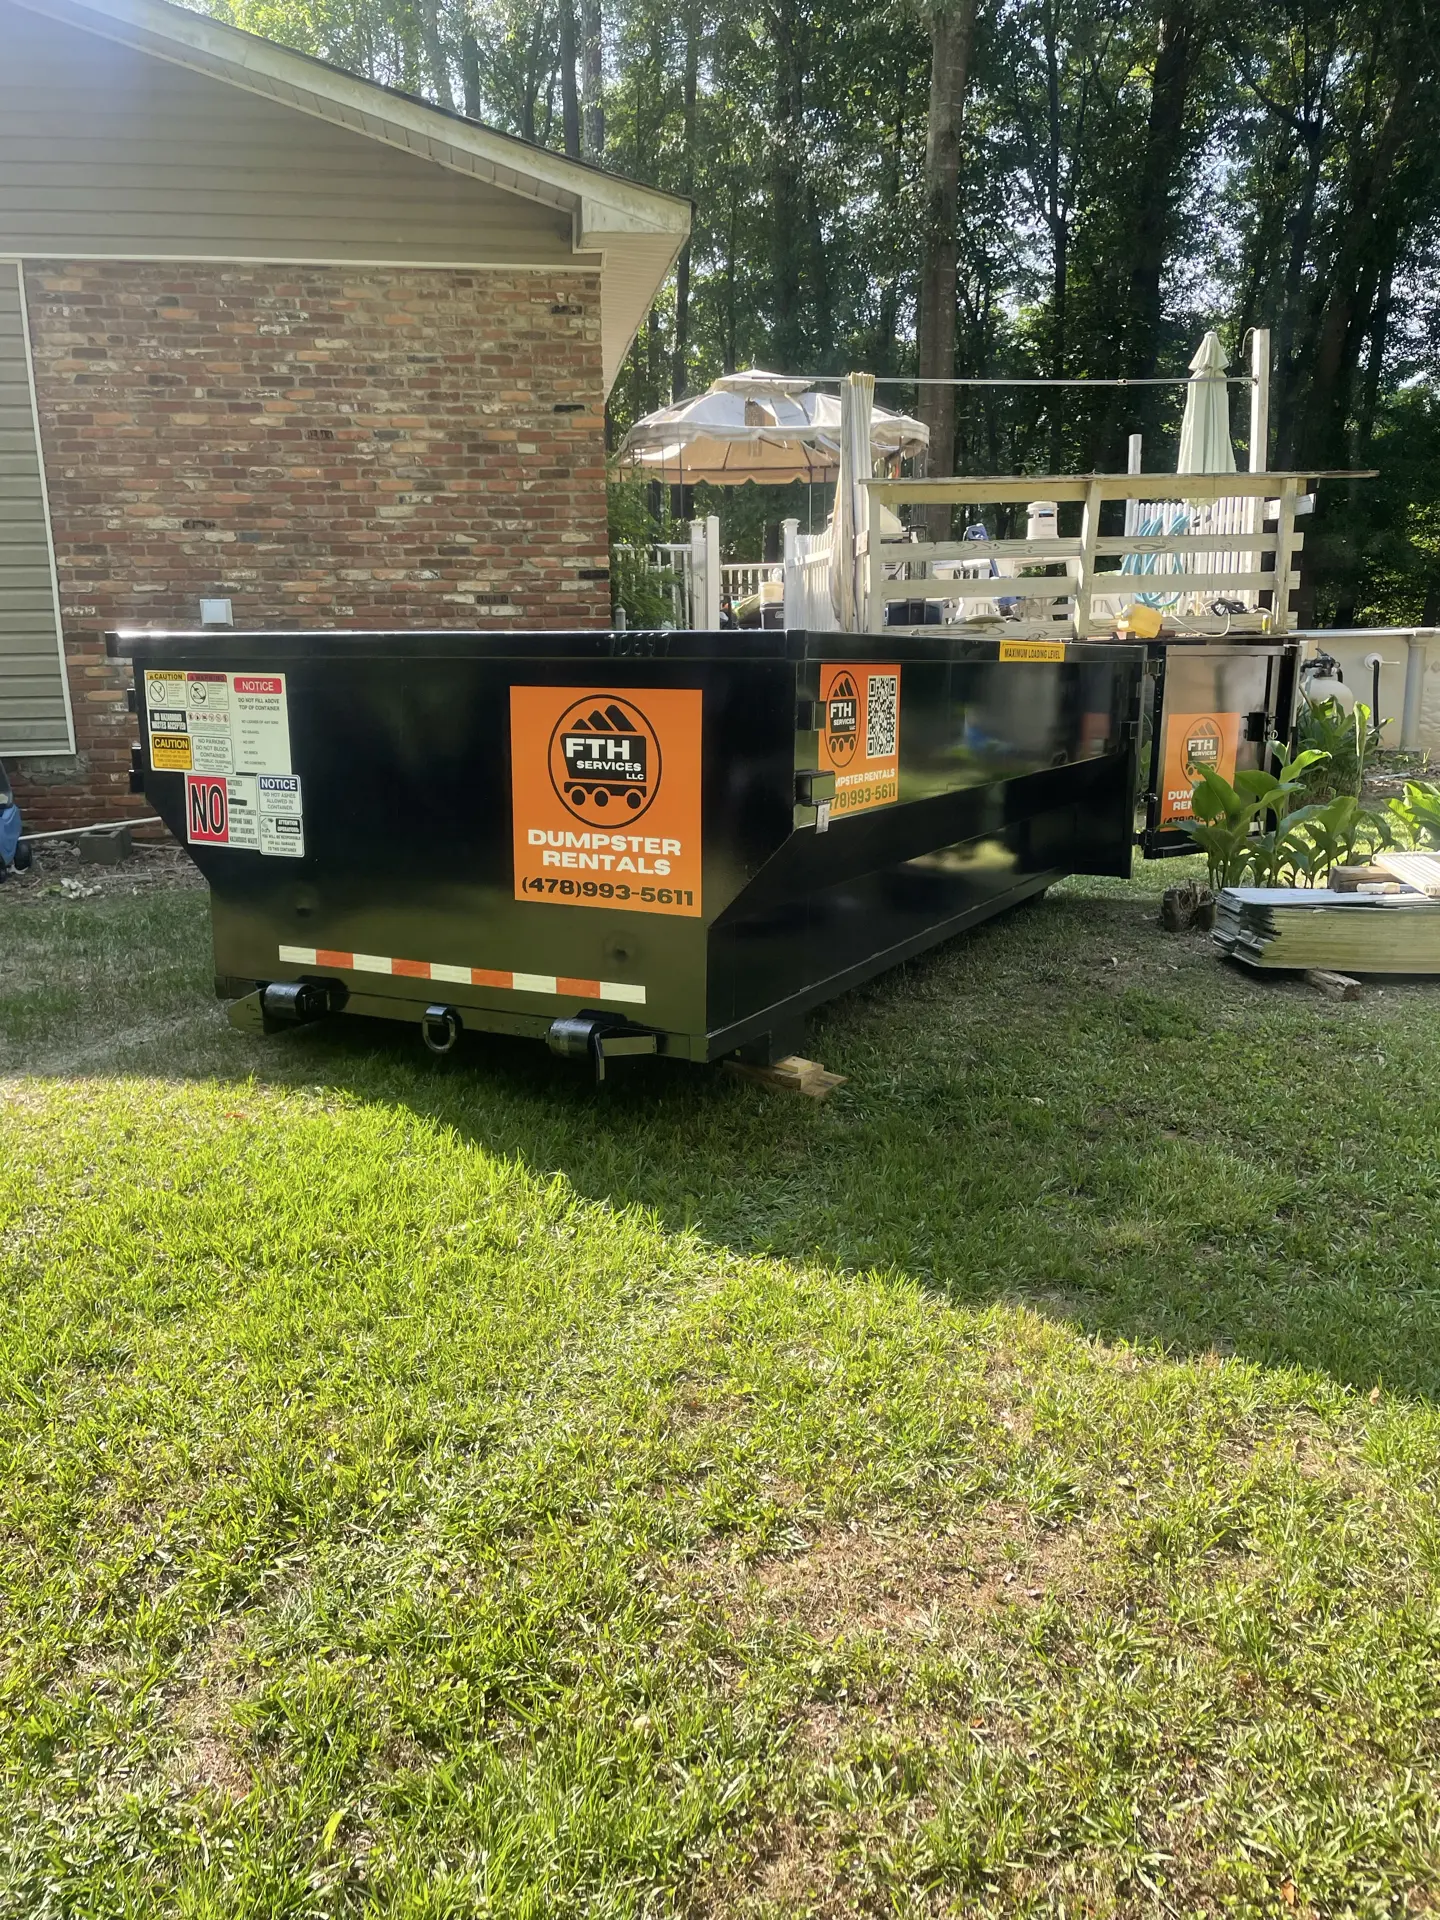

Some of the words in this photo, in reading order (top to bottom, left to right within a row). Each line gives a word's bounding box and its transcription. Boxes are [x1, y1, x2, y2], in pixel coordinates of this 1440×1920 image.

[1005, 648, 1027, 658] MAXIMUM
[1028, 649, 1047, 658] LOADING
[1048, 650, 1060, 659] LEVEL
[242, 681, 274, 691] NOTICE
[830, 702, 852, 718] FTH
[833, 717, 855, 726] SERVICES
[154, 739, 188, 749] CAUTION
[565, 737, 630, 760] FTH
[1188, 739, 1213, 751] FTH
[576, 760, 642, 772] SERVICES
[261, 778, 296, 790] NOTICE
[835, 773, 864, 787] MPSTER
[864, 768, 895, 782] RENTALS
[829, 782, 896, 810] 78)993-5611
[190, 783, 226, 836] NO
[527, 829, 681, 856] DUMPSTER
[542, 850, 671, 876] RENTALS
[521, 876, 694, 906] (478)993-5611
